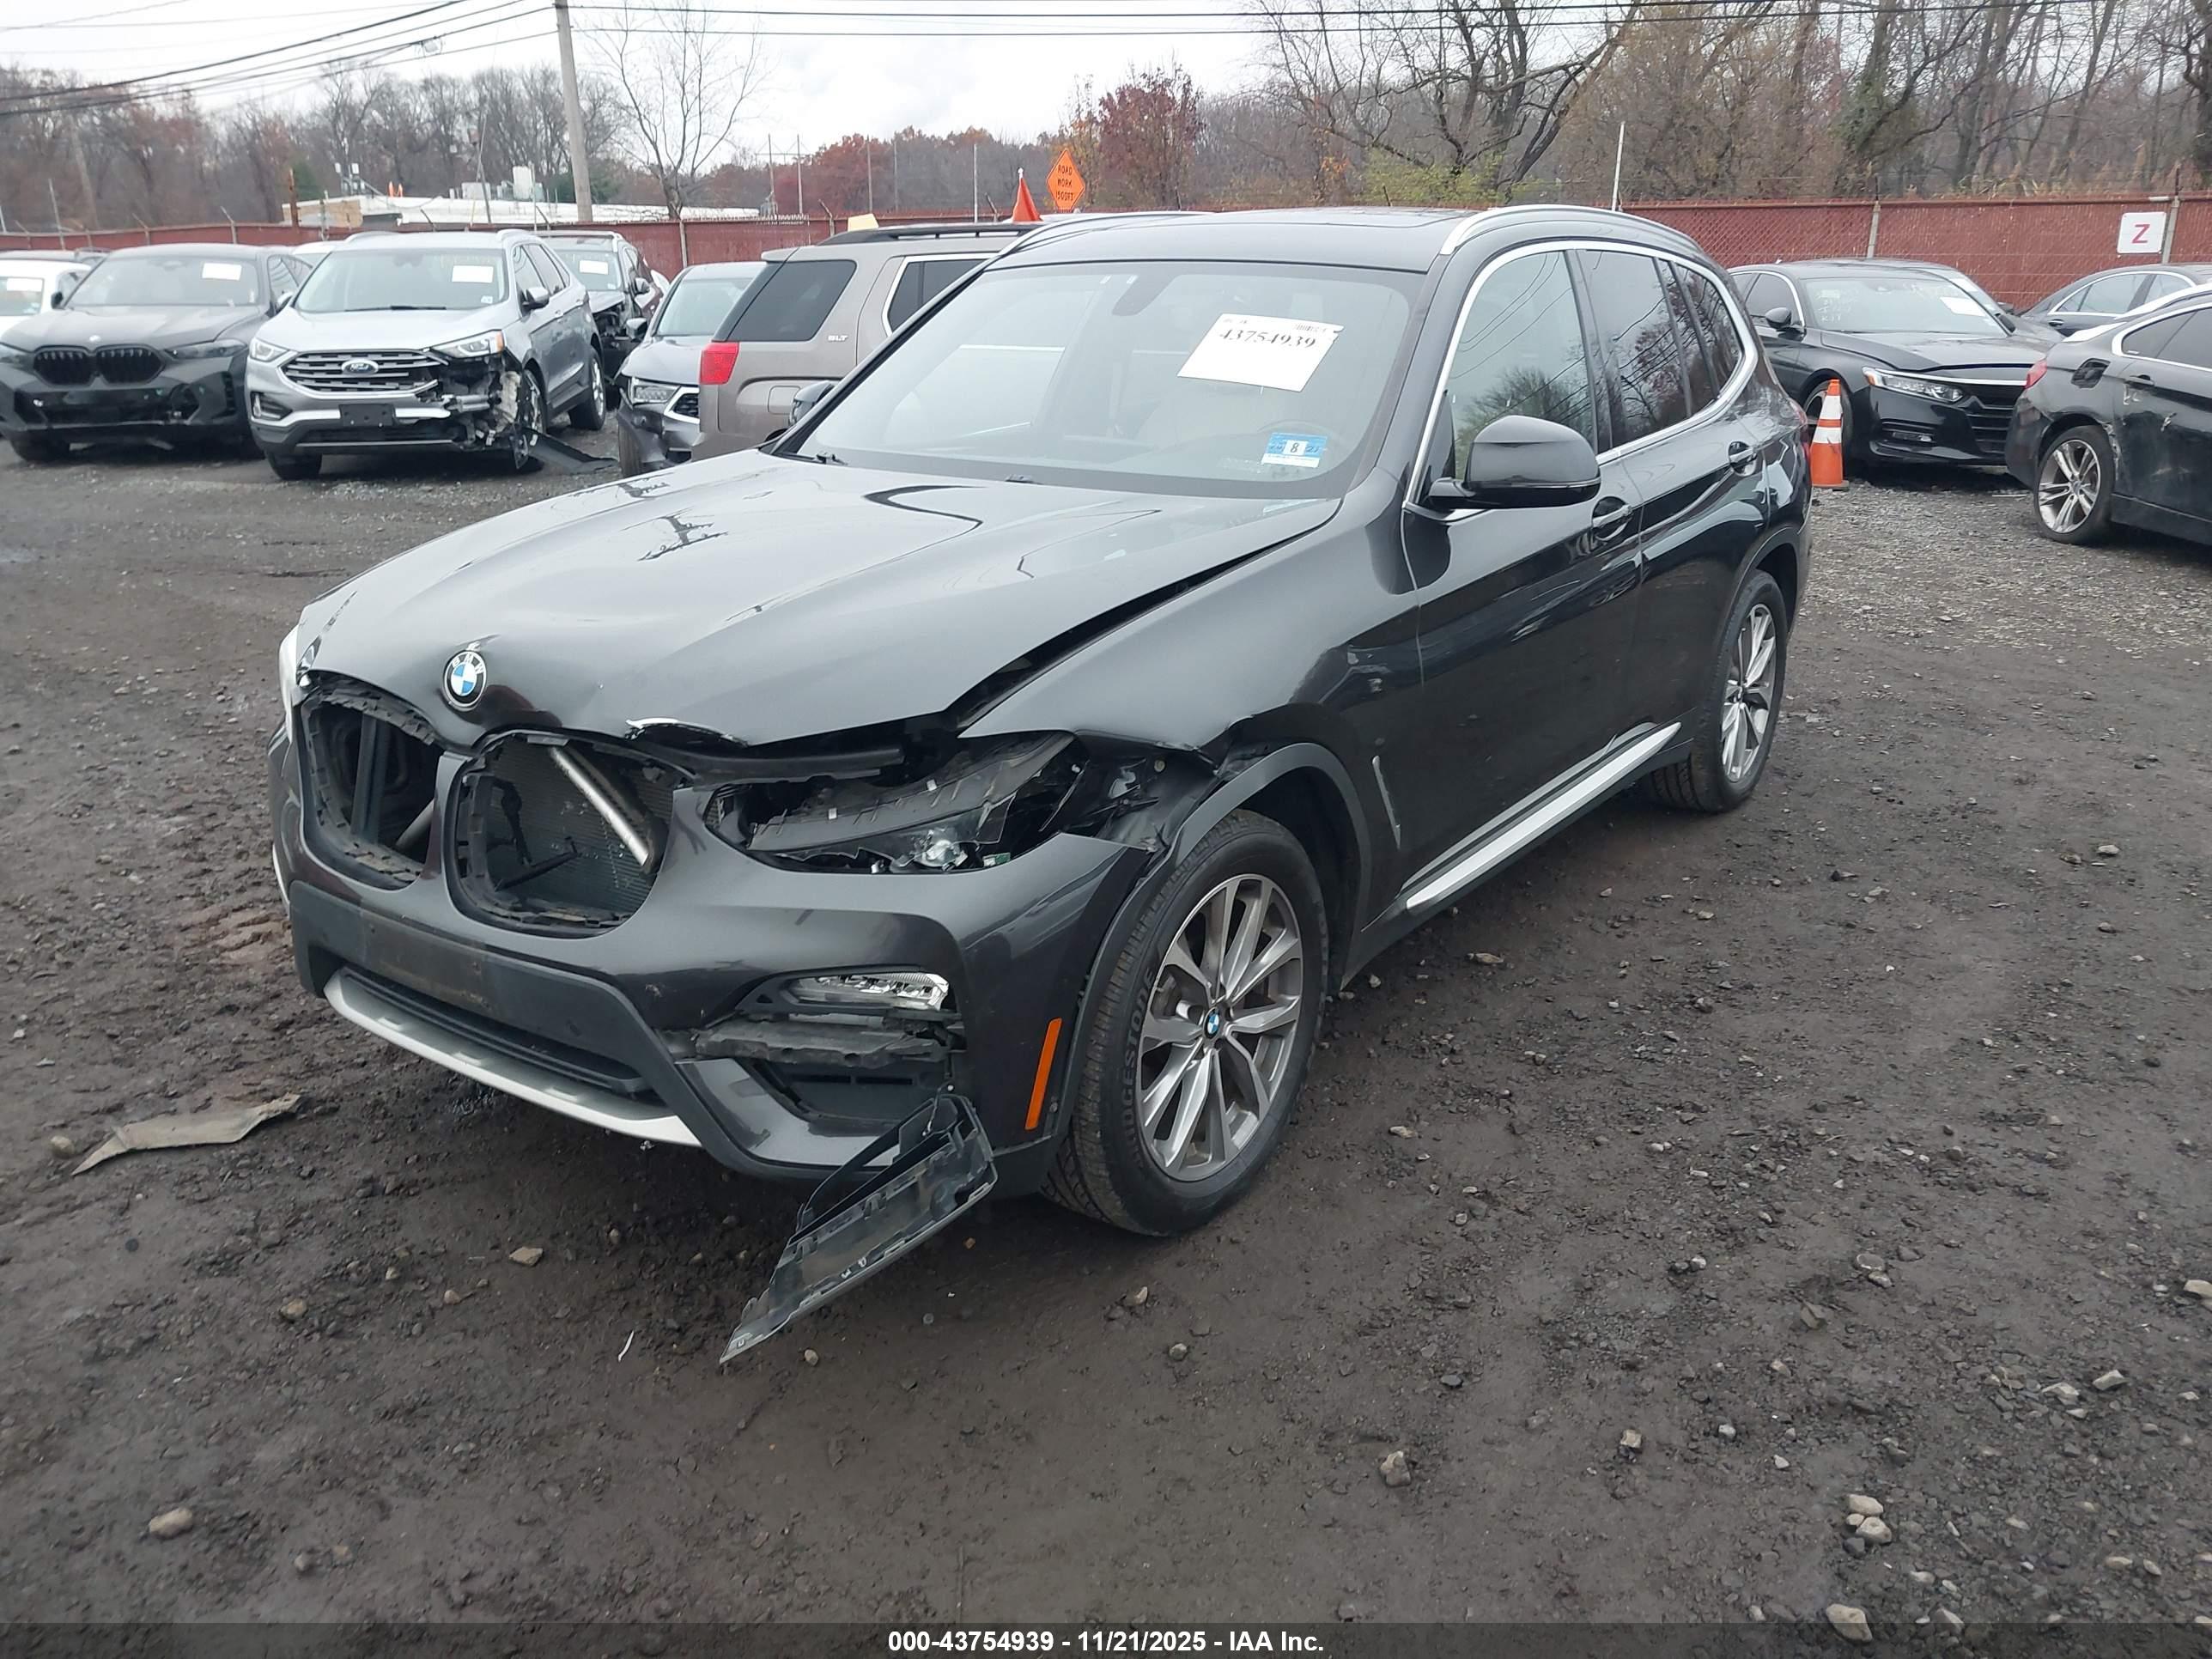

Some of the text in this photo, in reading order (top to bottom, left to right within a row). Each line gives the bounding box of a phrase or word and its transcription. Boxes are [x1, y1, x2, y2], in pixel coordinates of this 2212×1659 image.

[1057, 164, 1073, 176] ROAD
[1057, 178, 1073, 188] WORK
[2131, 223, 2150, 244] Z
[1219, 329, 1316, 348] 43754939
[1290, 442, 1299, 453] 8
[452, 653, 484, 676] BMW
